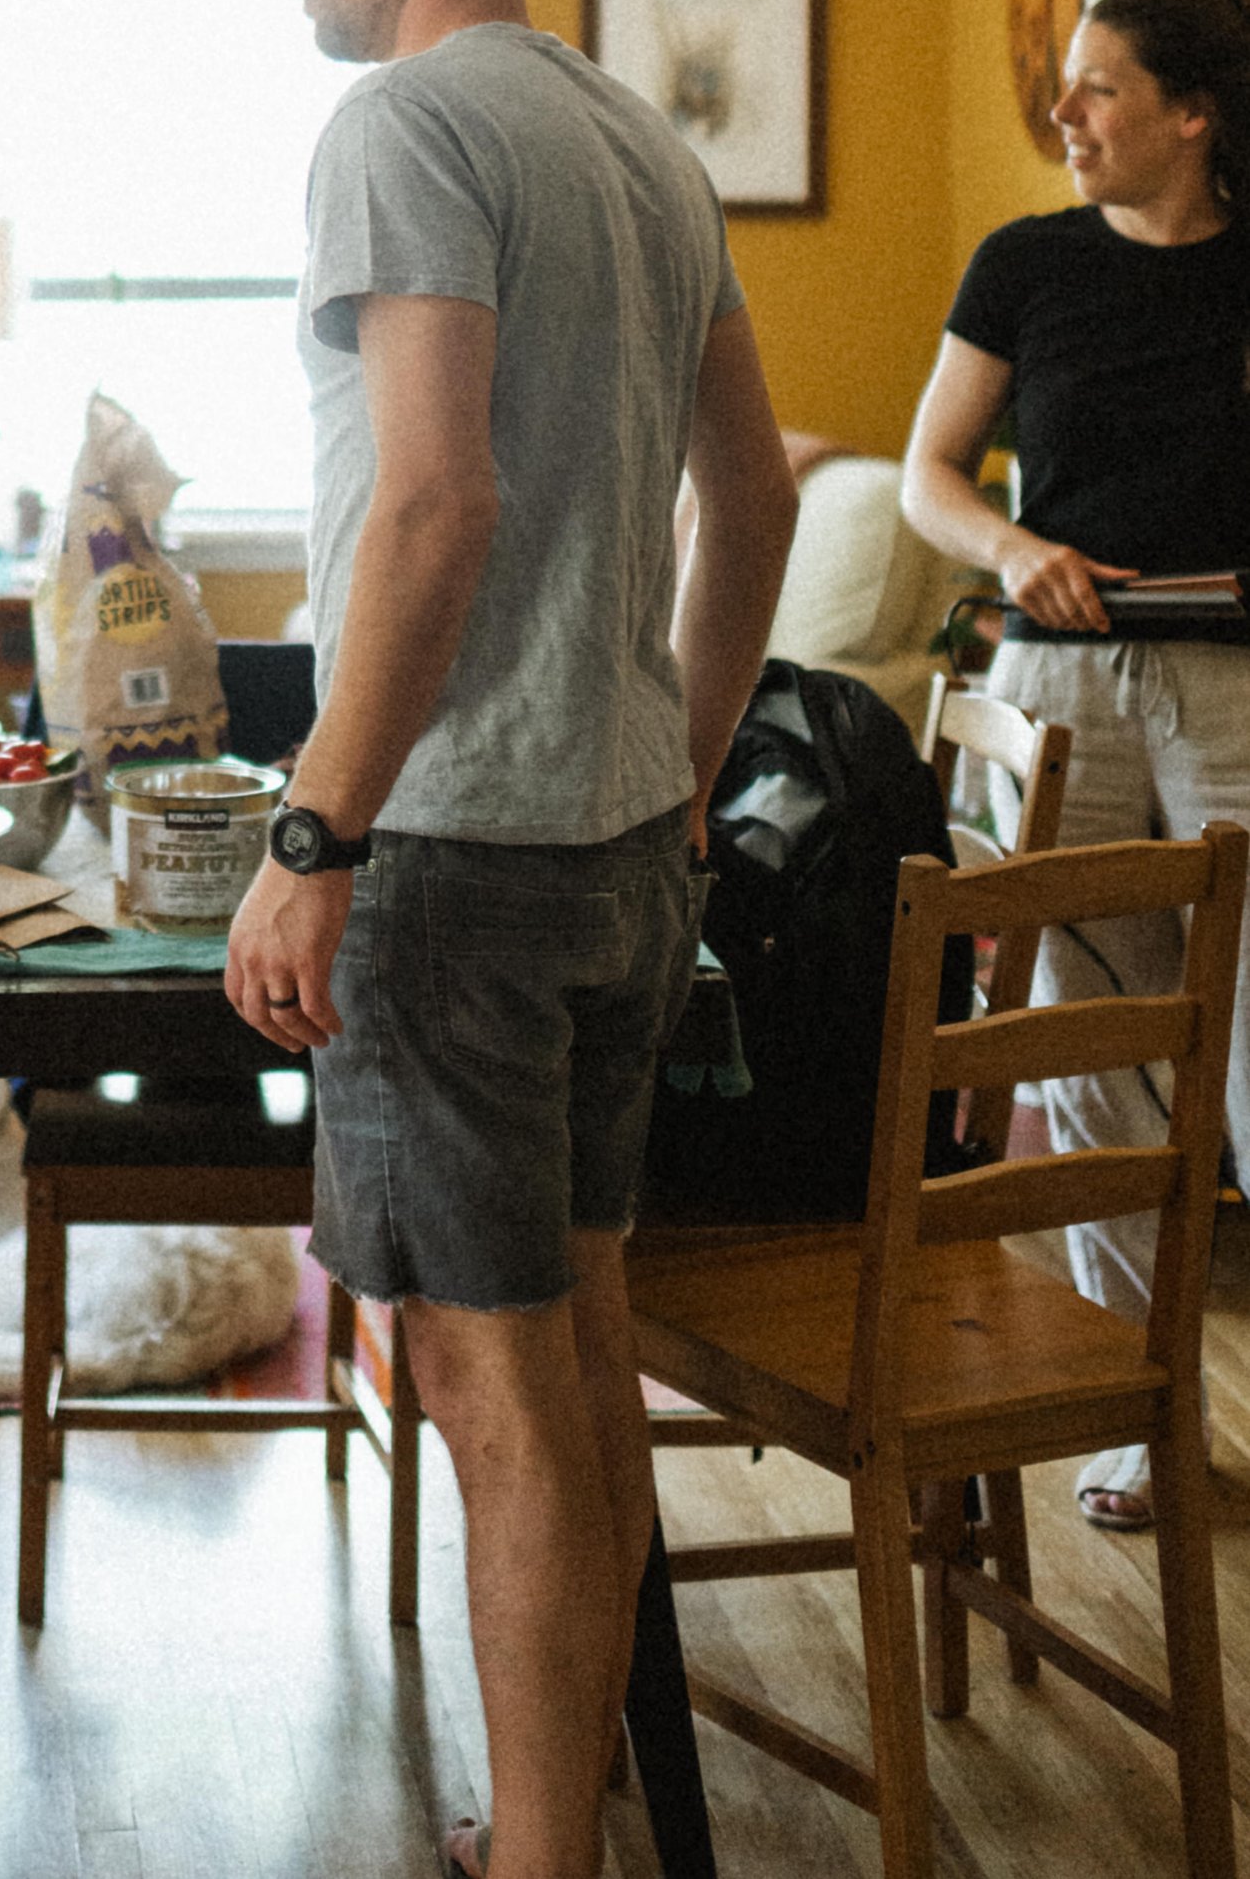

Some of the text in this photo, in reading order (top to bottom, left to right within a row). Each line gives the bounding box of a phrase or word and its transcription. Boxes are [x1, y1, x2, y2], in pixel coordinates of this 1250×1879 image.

[100, 576, 165, 606] ORTILL
[98, 598, 171, 632] STRIPS
[167, 811, 228, 824] KIRKLAND
